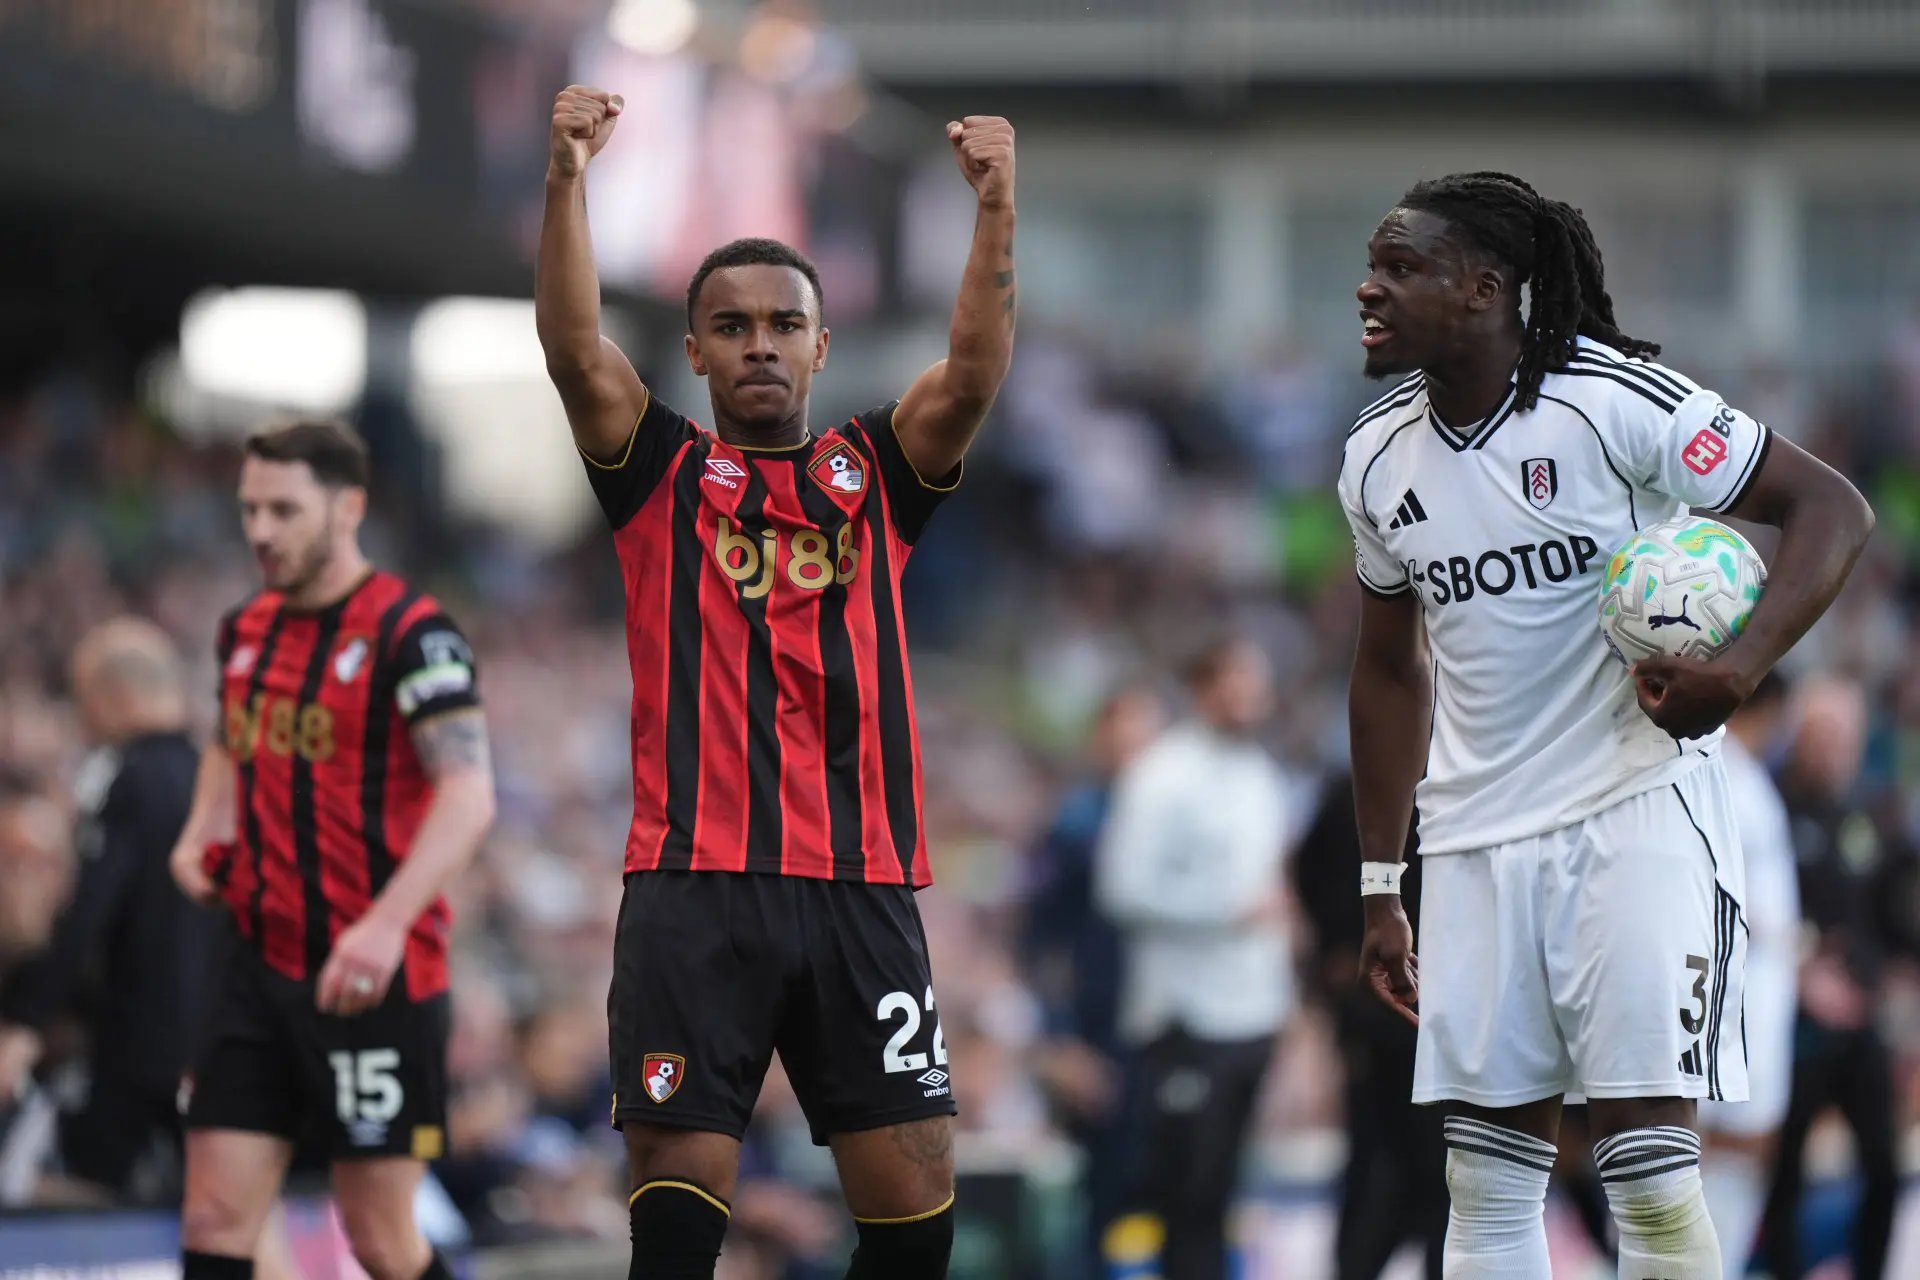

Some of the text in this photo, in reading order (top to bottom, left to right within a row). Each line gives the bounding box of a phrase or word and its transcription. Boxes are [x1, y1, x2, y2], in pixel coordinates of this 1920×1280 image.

[704, 472, 737, 489] umbro
[1531, 463, 1548, 500] FFC
[714, 516, 861, 599] bj88
[1427, 535, 1598, 606] SBOTOP
[1679, 953, 1709, 1035] 3
[328, 1047, 404, 1124] 15
[923, 1086, 949, 1098] umbro
